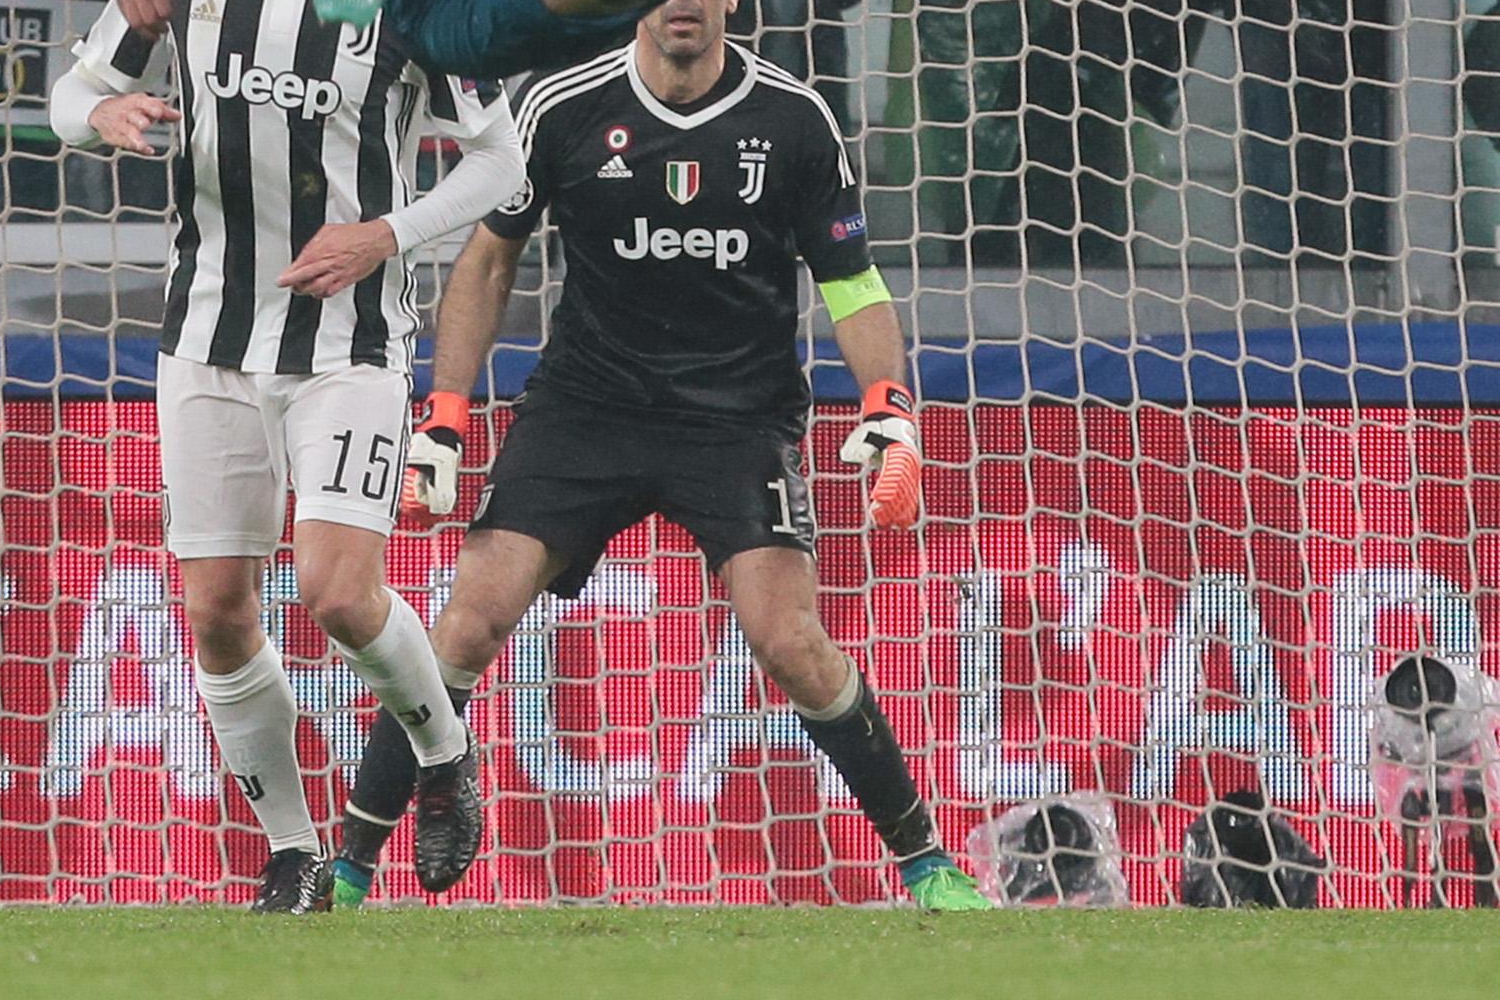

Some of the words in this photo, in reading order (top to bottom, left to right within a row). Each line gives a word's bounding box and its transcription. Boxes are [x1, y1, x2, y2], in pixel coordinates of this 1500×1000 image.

[205, 52, 342, 121] Jeep
[613, 217, 749, 270] Jeep
[321, 429, 395, 501] 15
[767, 478, 799, 535] 1
